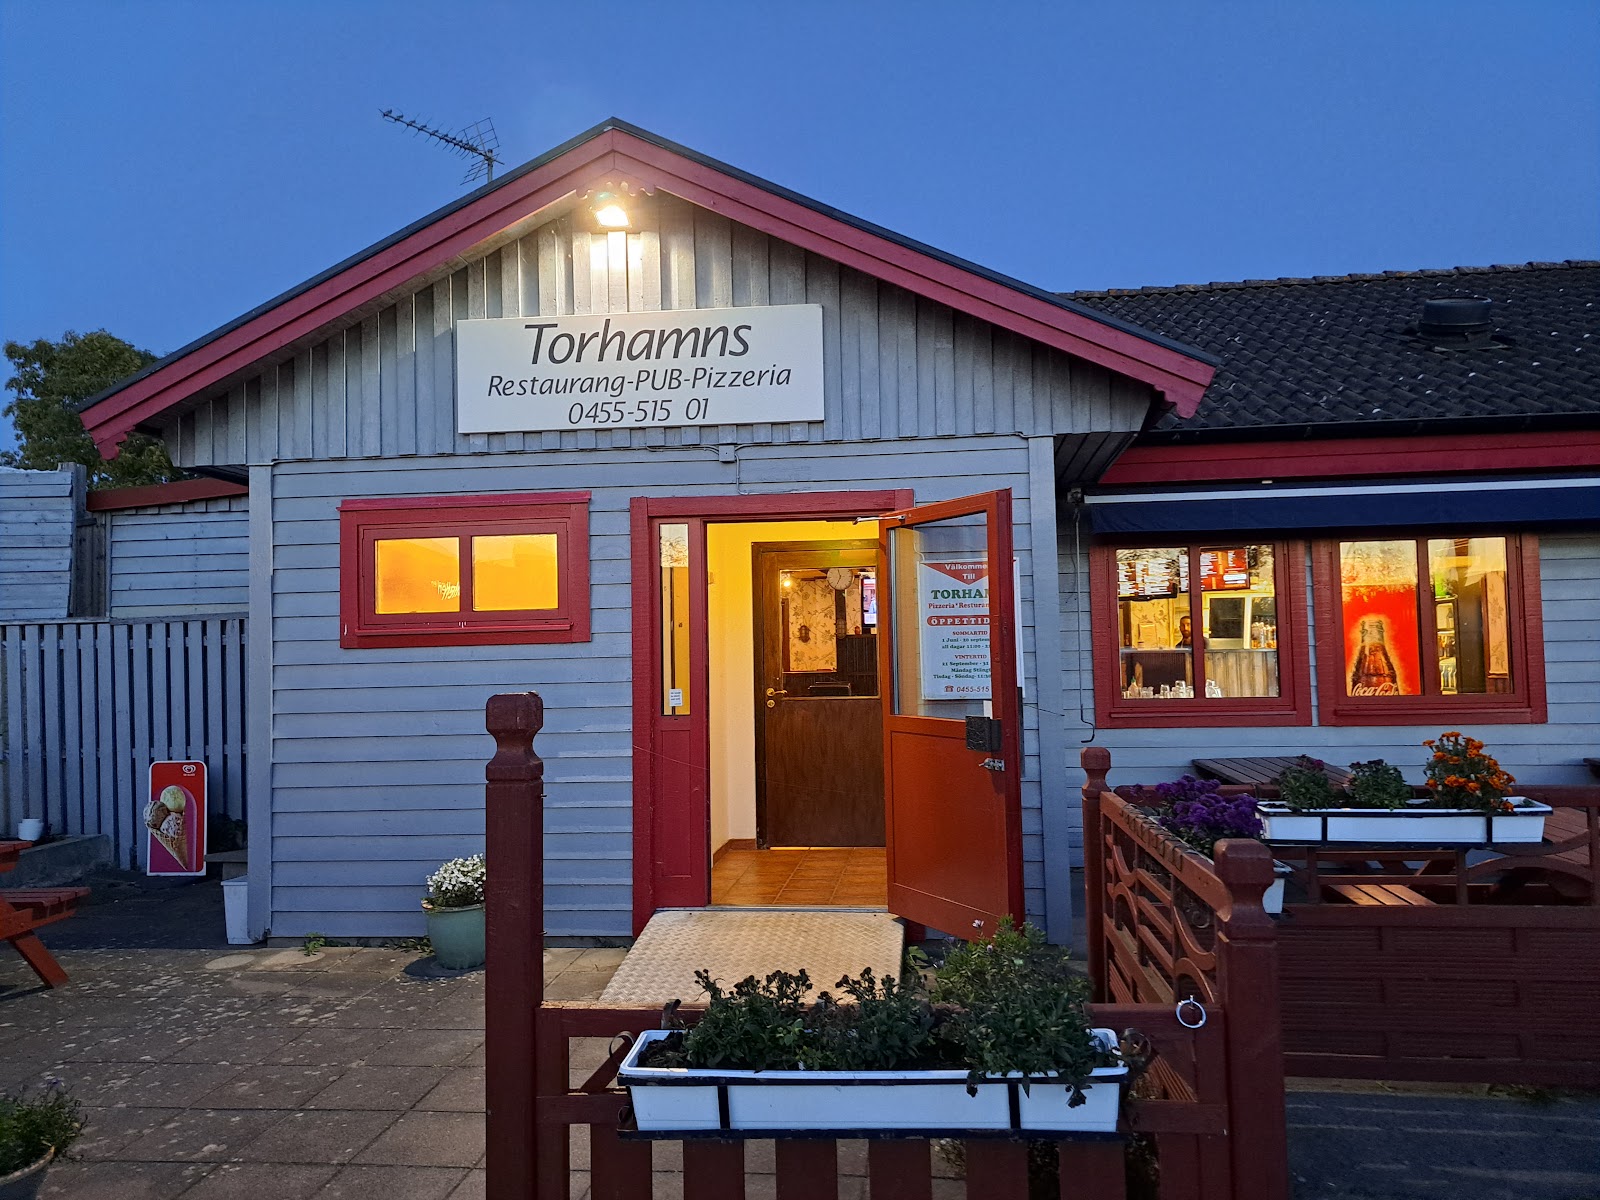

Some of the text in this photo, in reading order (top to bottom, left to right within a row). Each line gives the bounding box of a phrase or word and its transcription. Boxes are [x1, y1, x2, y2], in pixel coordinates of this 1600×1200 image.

[524, 318, 752, 365] Torhamns
[487, 364, 792, 398] Restaurang-PUB-Pizzeria
[568, 398, 709, 425] 0455-515 01
